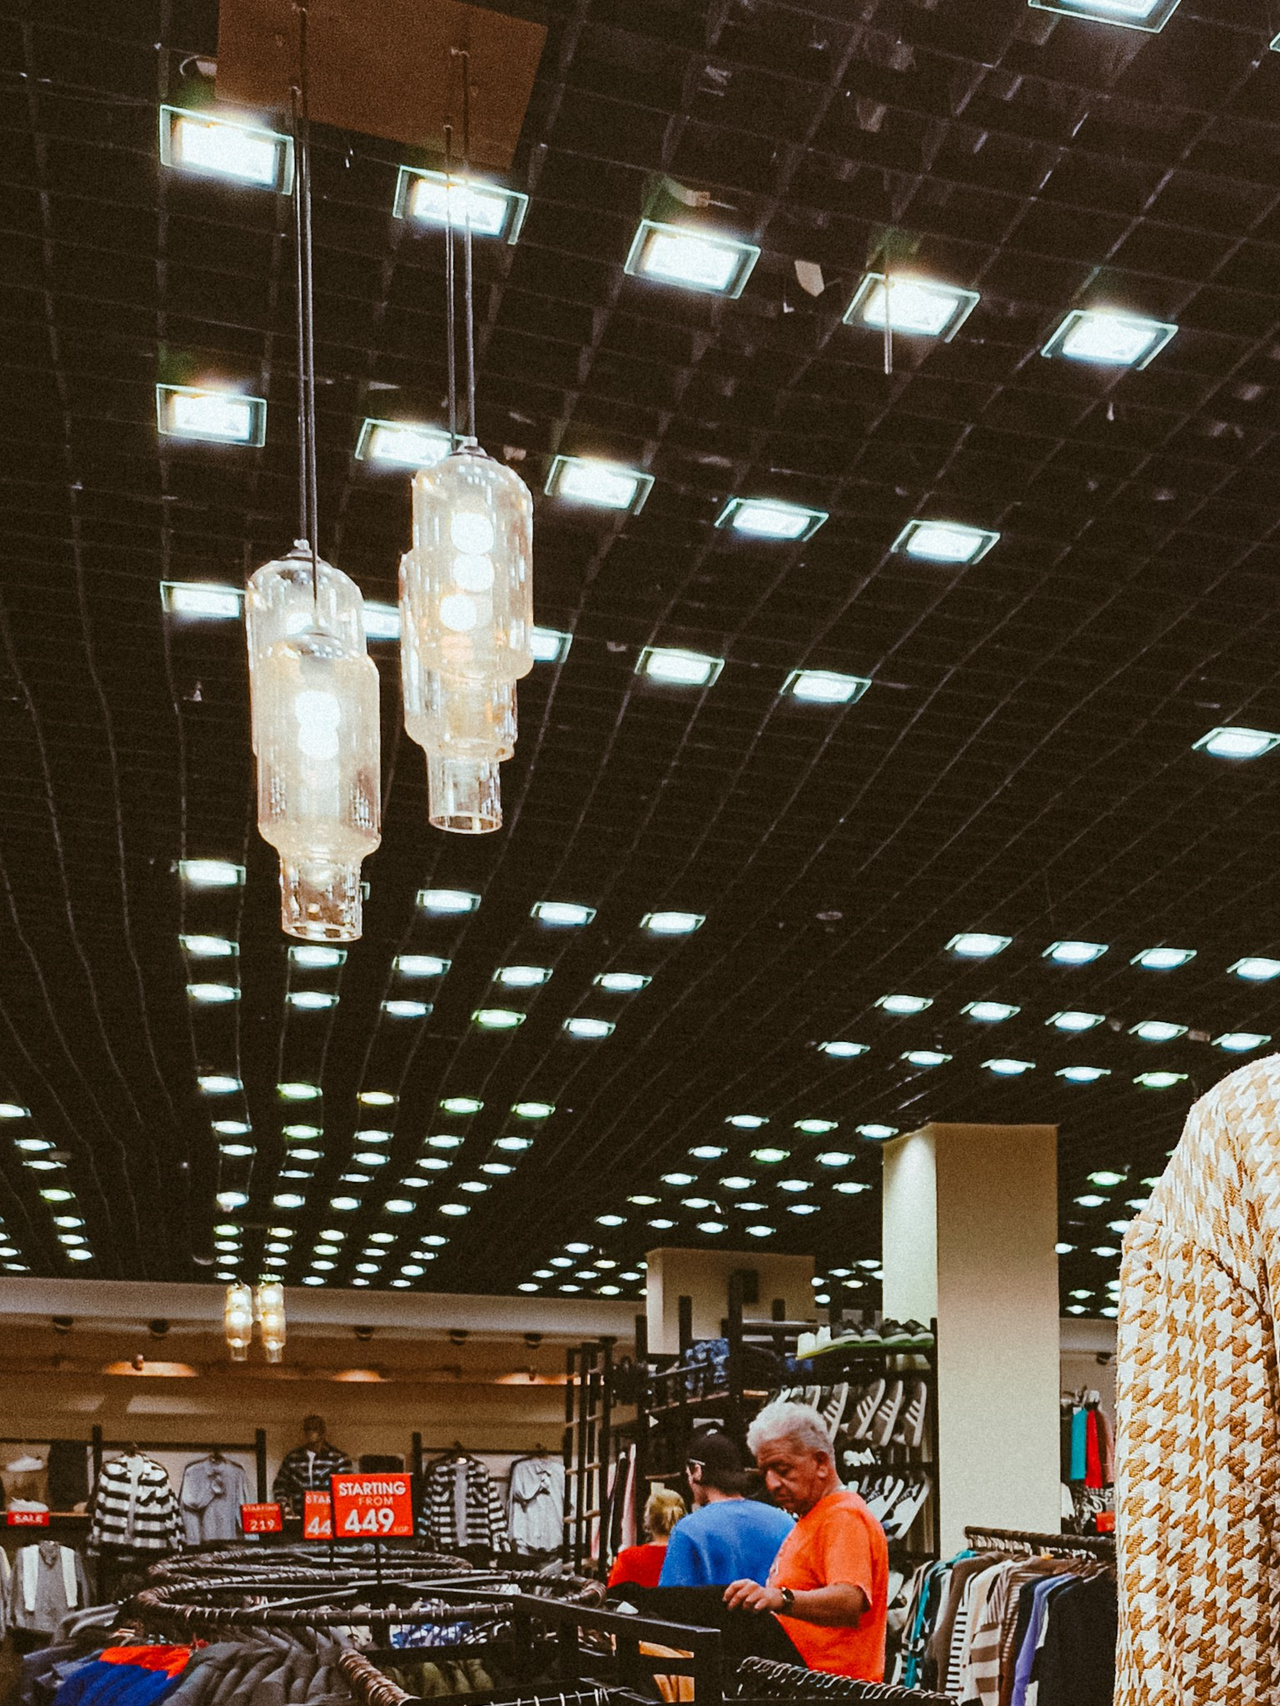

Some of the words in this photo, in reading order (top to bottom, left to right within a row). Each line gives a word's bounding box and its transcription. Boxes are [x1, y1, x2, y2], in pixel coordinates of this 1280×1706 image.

[338, 1481, 406, 1496] STARTING
[358, 1496, 394, 1506] FROM
[13, 1513, 43, 1524] SALE
[344, 1508, 395, 1533] 449
[250, 1519, 275, 1531] 219
